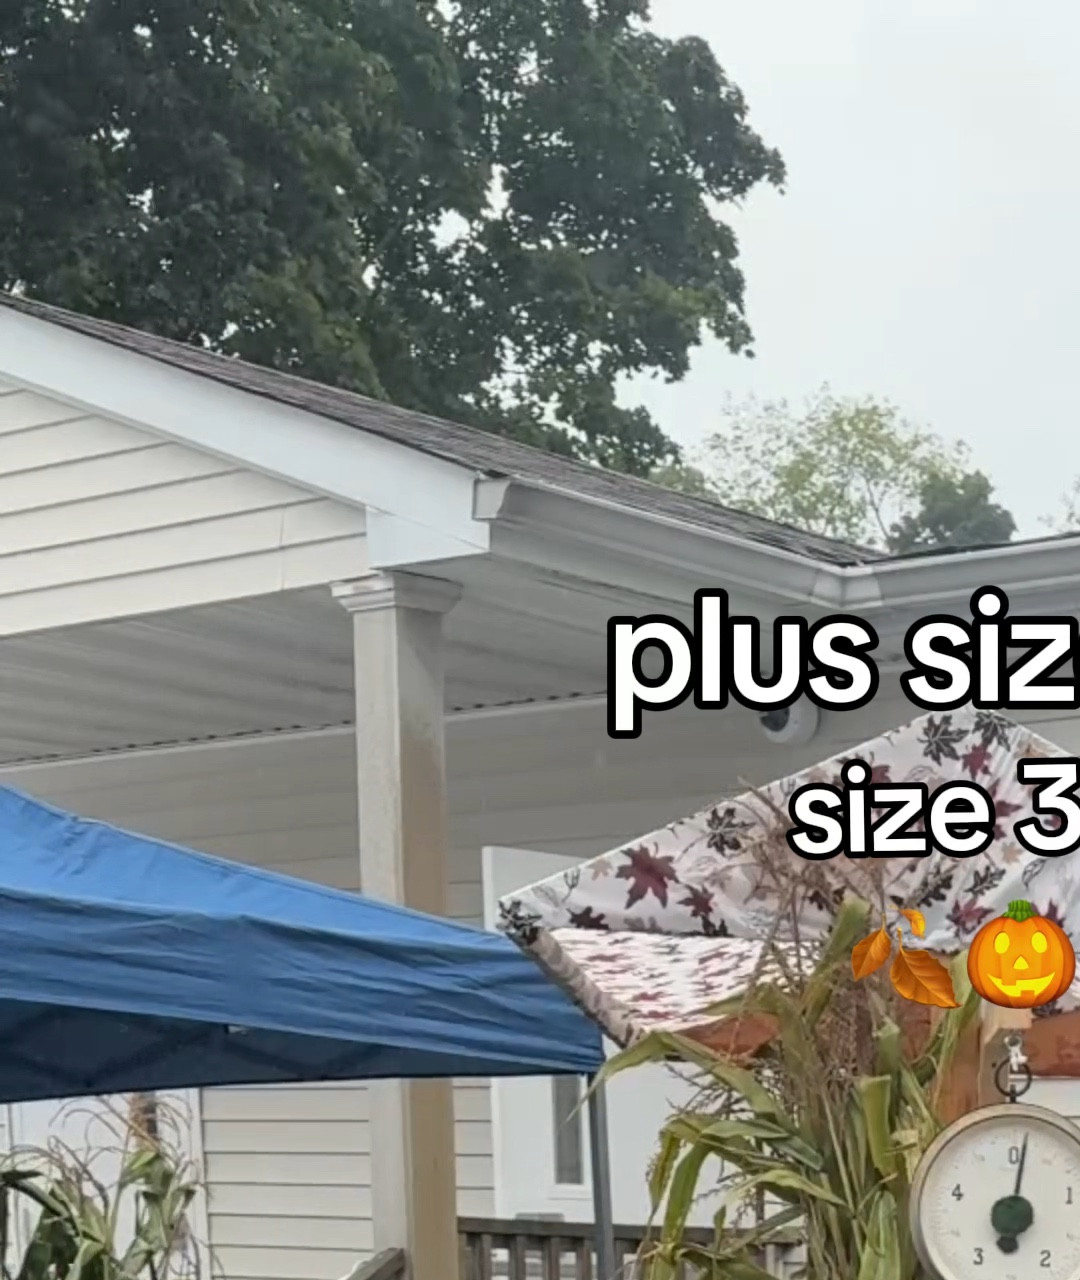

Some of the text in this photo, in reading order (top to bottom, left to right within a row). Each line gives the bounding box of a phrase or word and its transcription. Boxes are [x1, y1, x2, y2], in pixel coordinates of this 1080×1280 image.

[1008, 1146, 1019, 1165] 0
[952, 1183, 964, 1201] 4
[1065, 1186, 1073, 1204] 1
[973, 1248, 984, 1265] 3
[1040, 1250, 1051, 1267] 2
